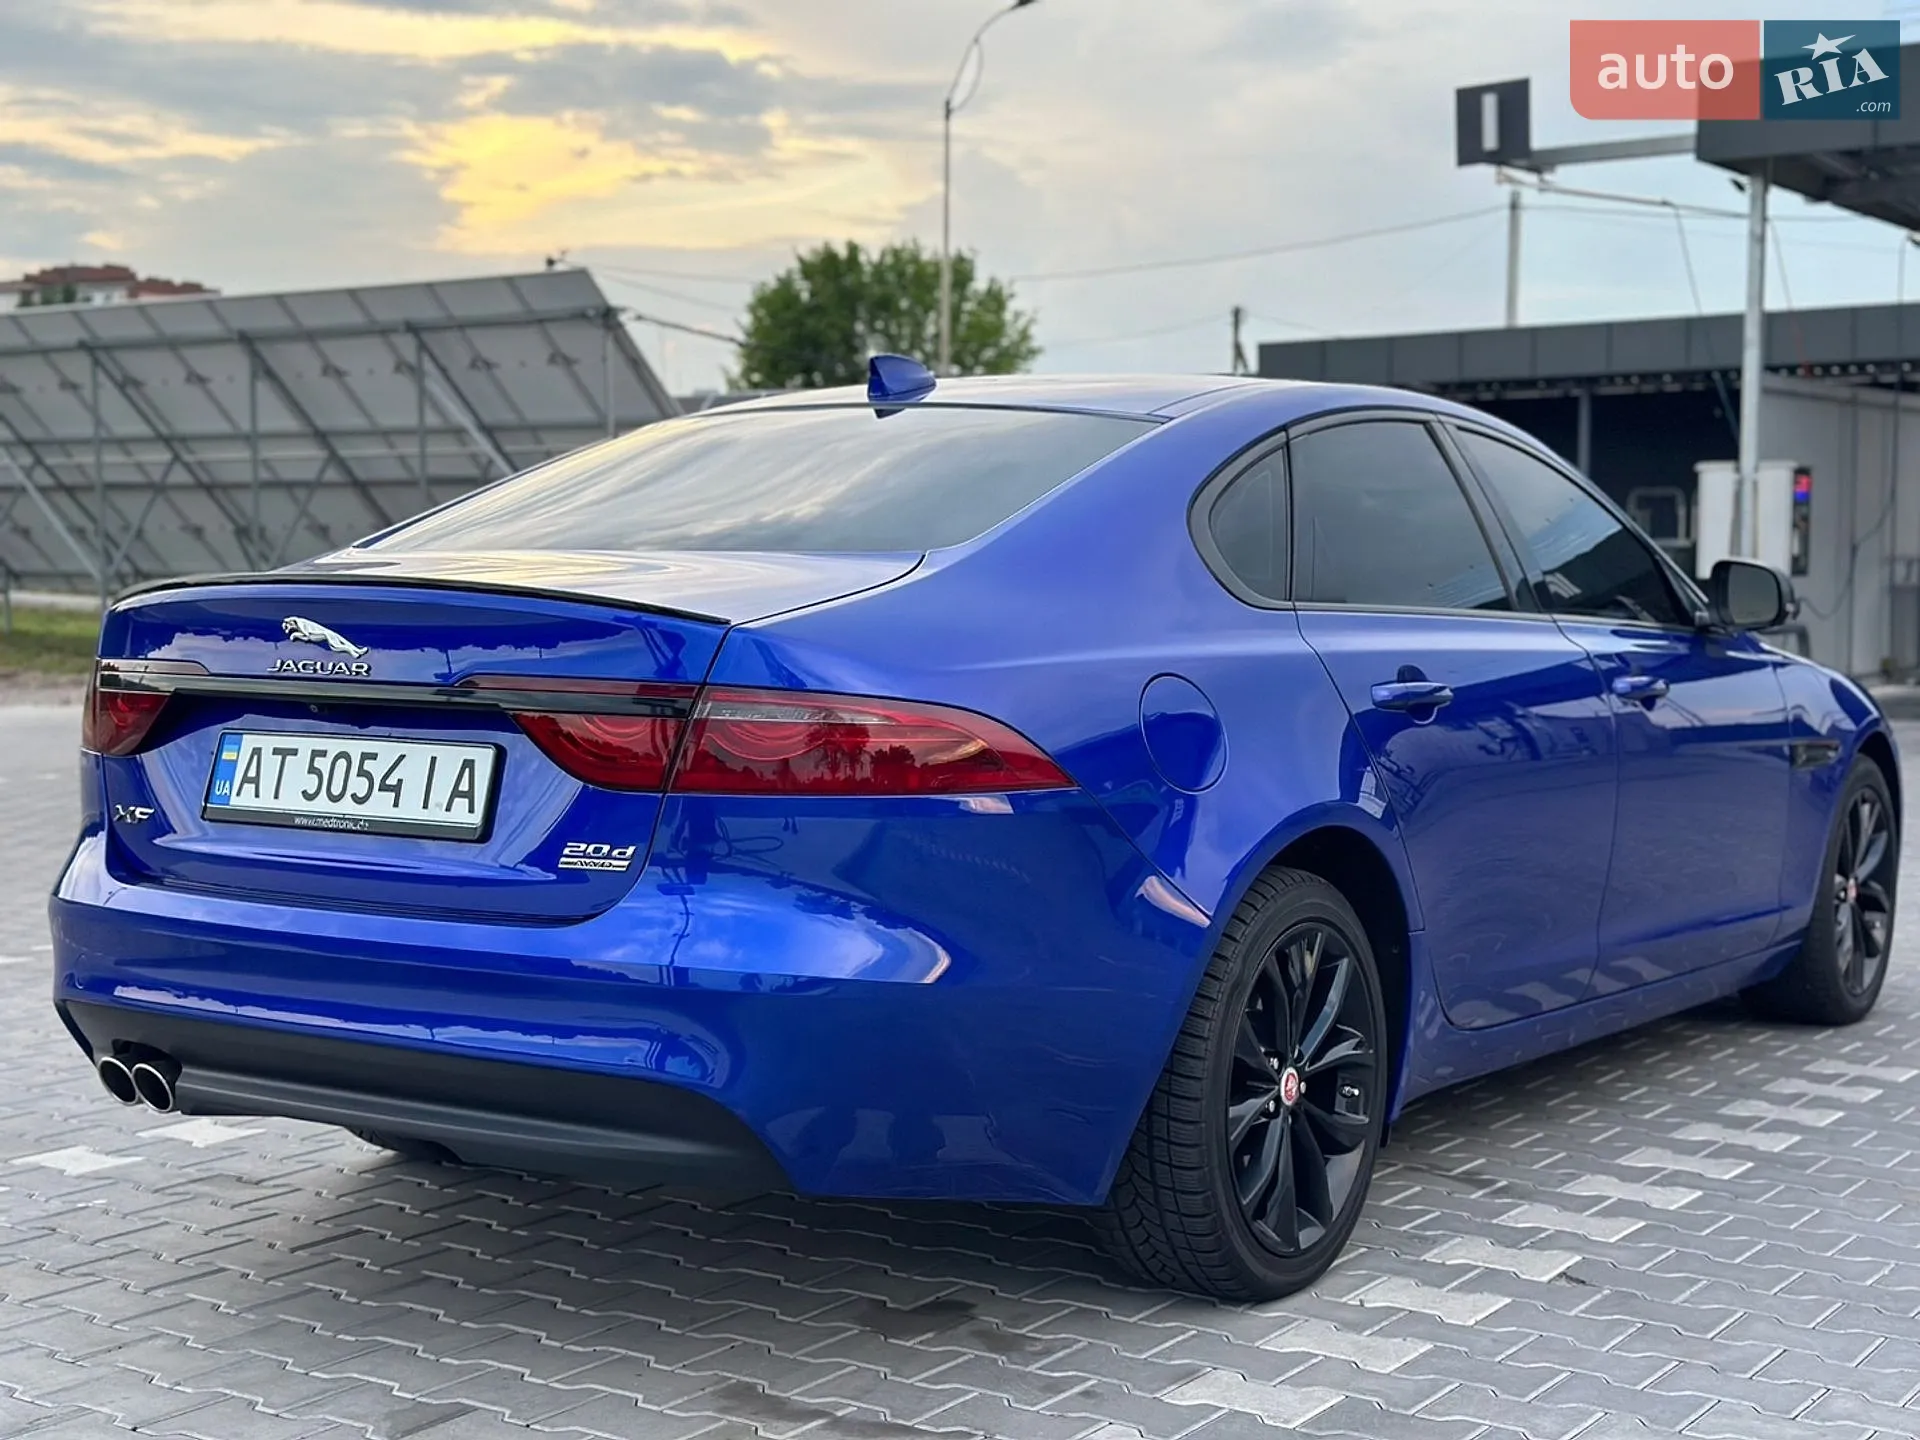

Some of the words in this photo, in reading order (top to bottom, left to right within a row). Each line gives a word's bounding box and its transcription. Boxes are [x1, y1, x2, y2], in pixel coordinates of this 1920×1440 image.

[266, 659, 369, 676] JAGUAR
[215, 779, 231, 796] UA
[236, 746, 298, 800] AT
[301, 749, 406, 808] 5054
[422, 756, 475, 814] IA
[113, 804, 155, 824] XF
